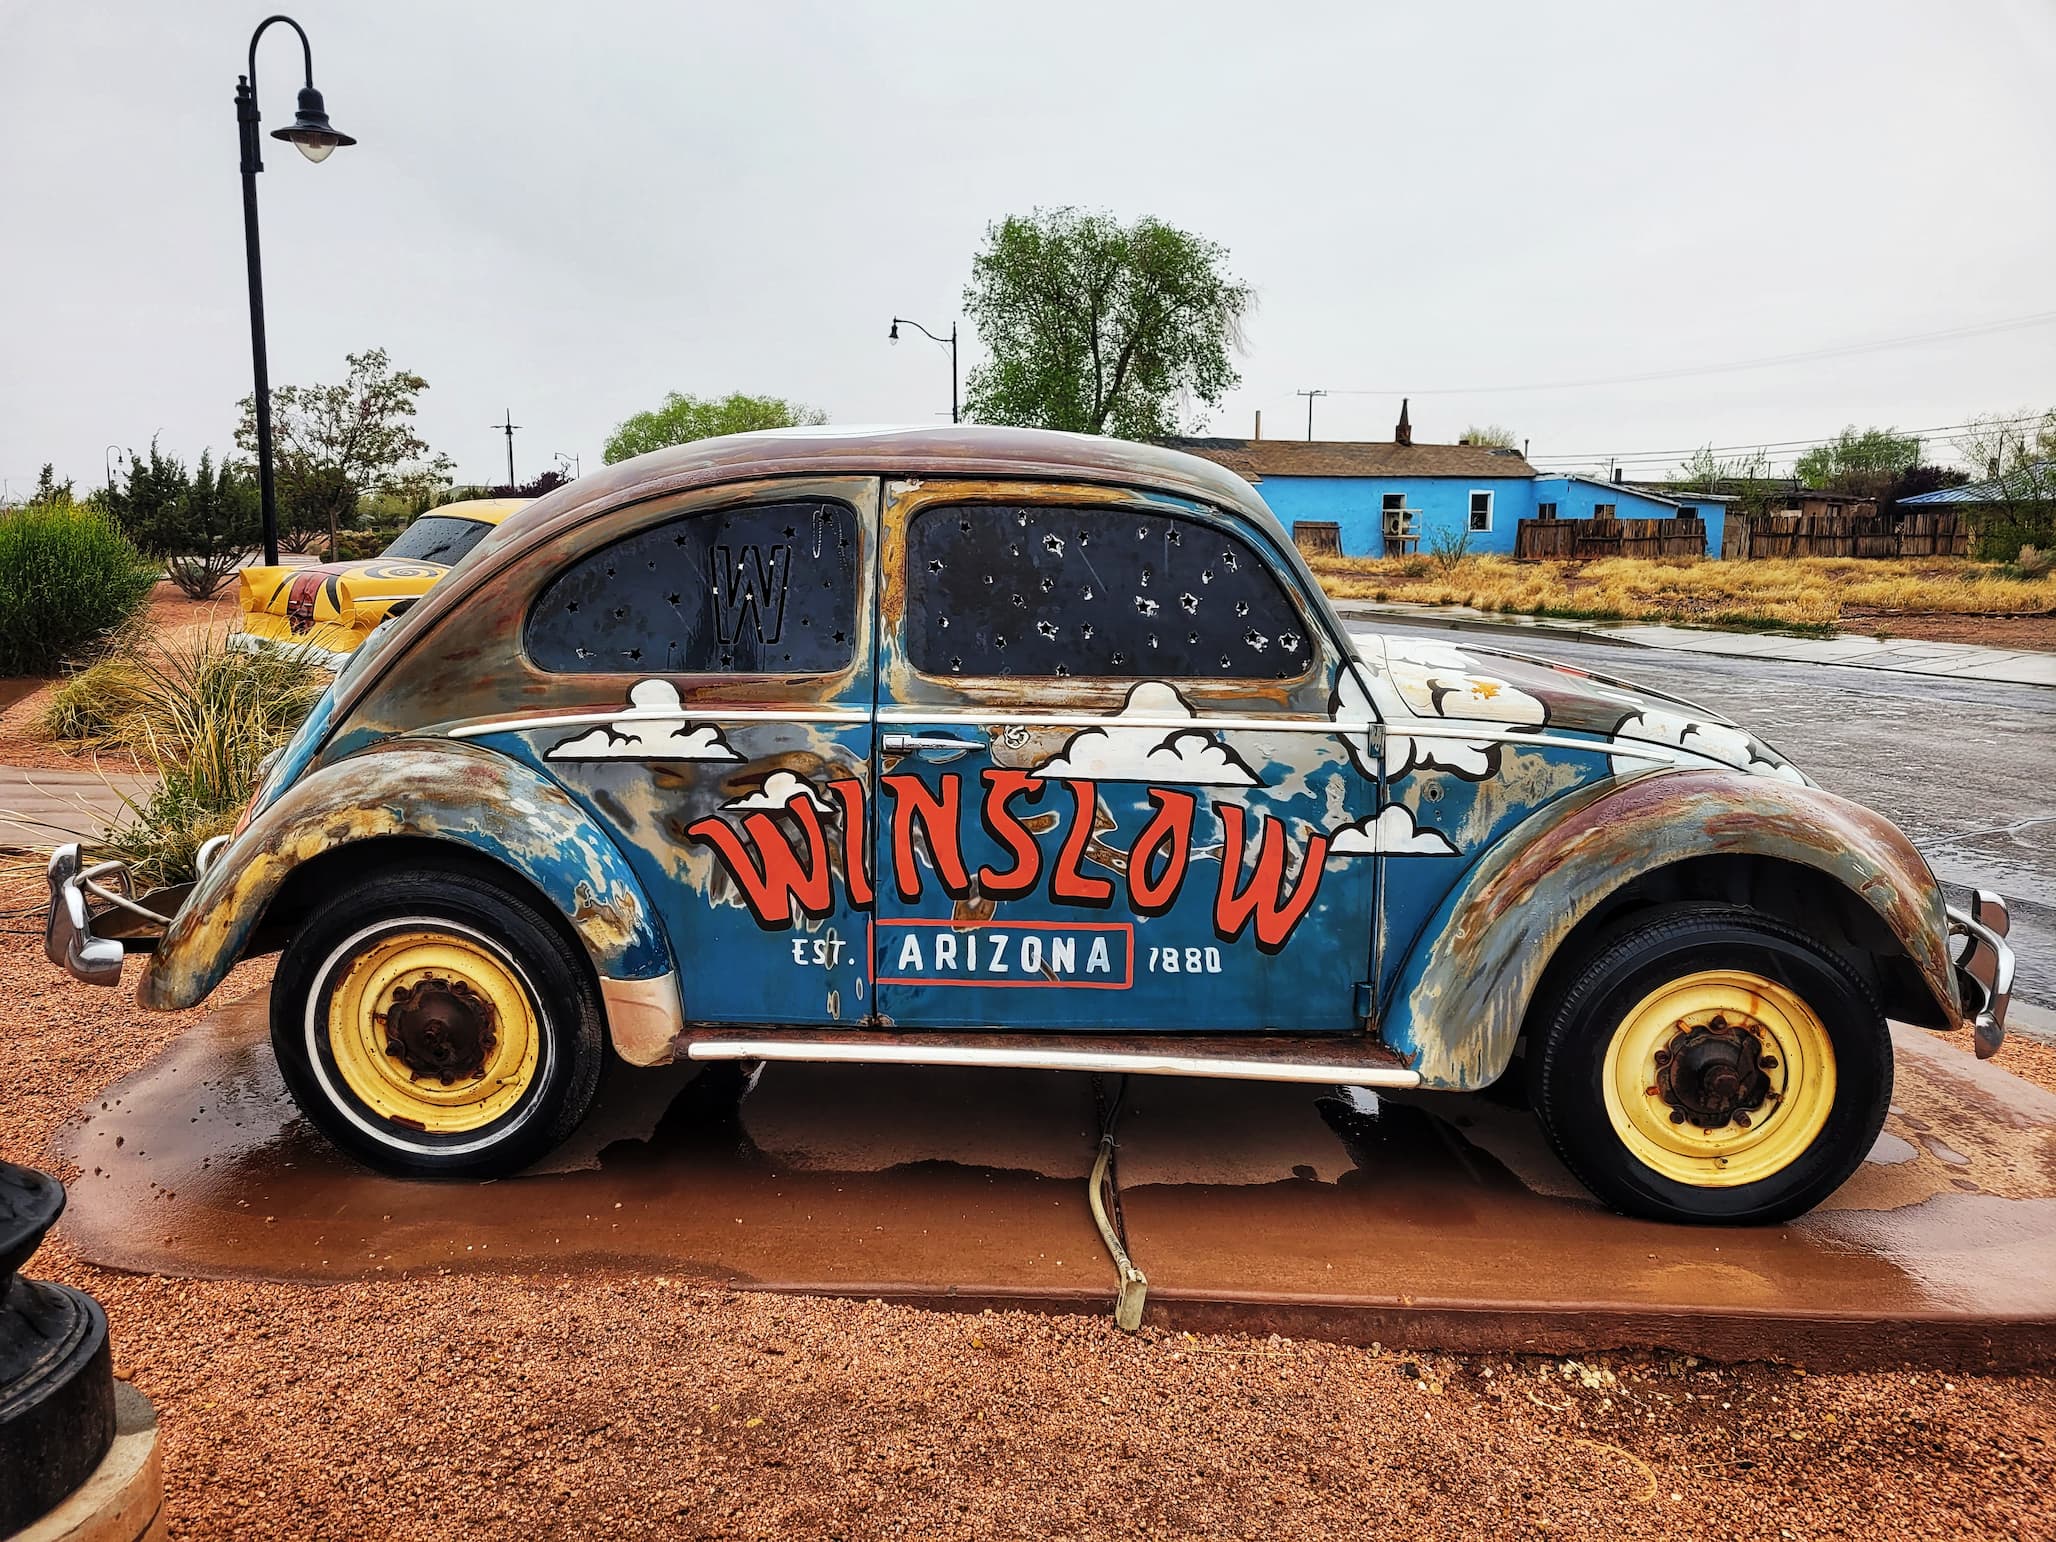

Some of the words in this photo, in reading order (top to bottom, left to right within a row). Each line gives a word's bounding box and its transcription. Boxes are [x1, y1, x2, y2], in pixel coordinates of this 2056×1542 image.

[709, 545, 791, 644] W
[688, 769, 1327, 954] WINSLOW
[791, 939, 854, 965] EST.
[898, 934, 1110, 973] ARIZONA
[1149, 947, 1222, 973] 1880
